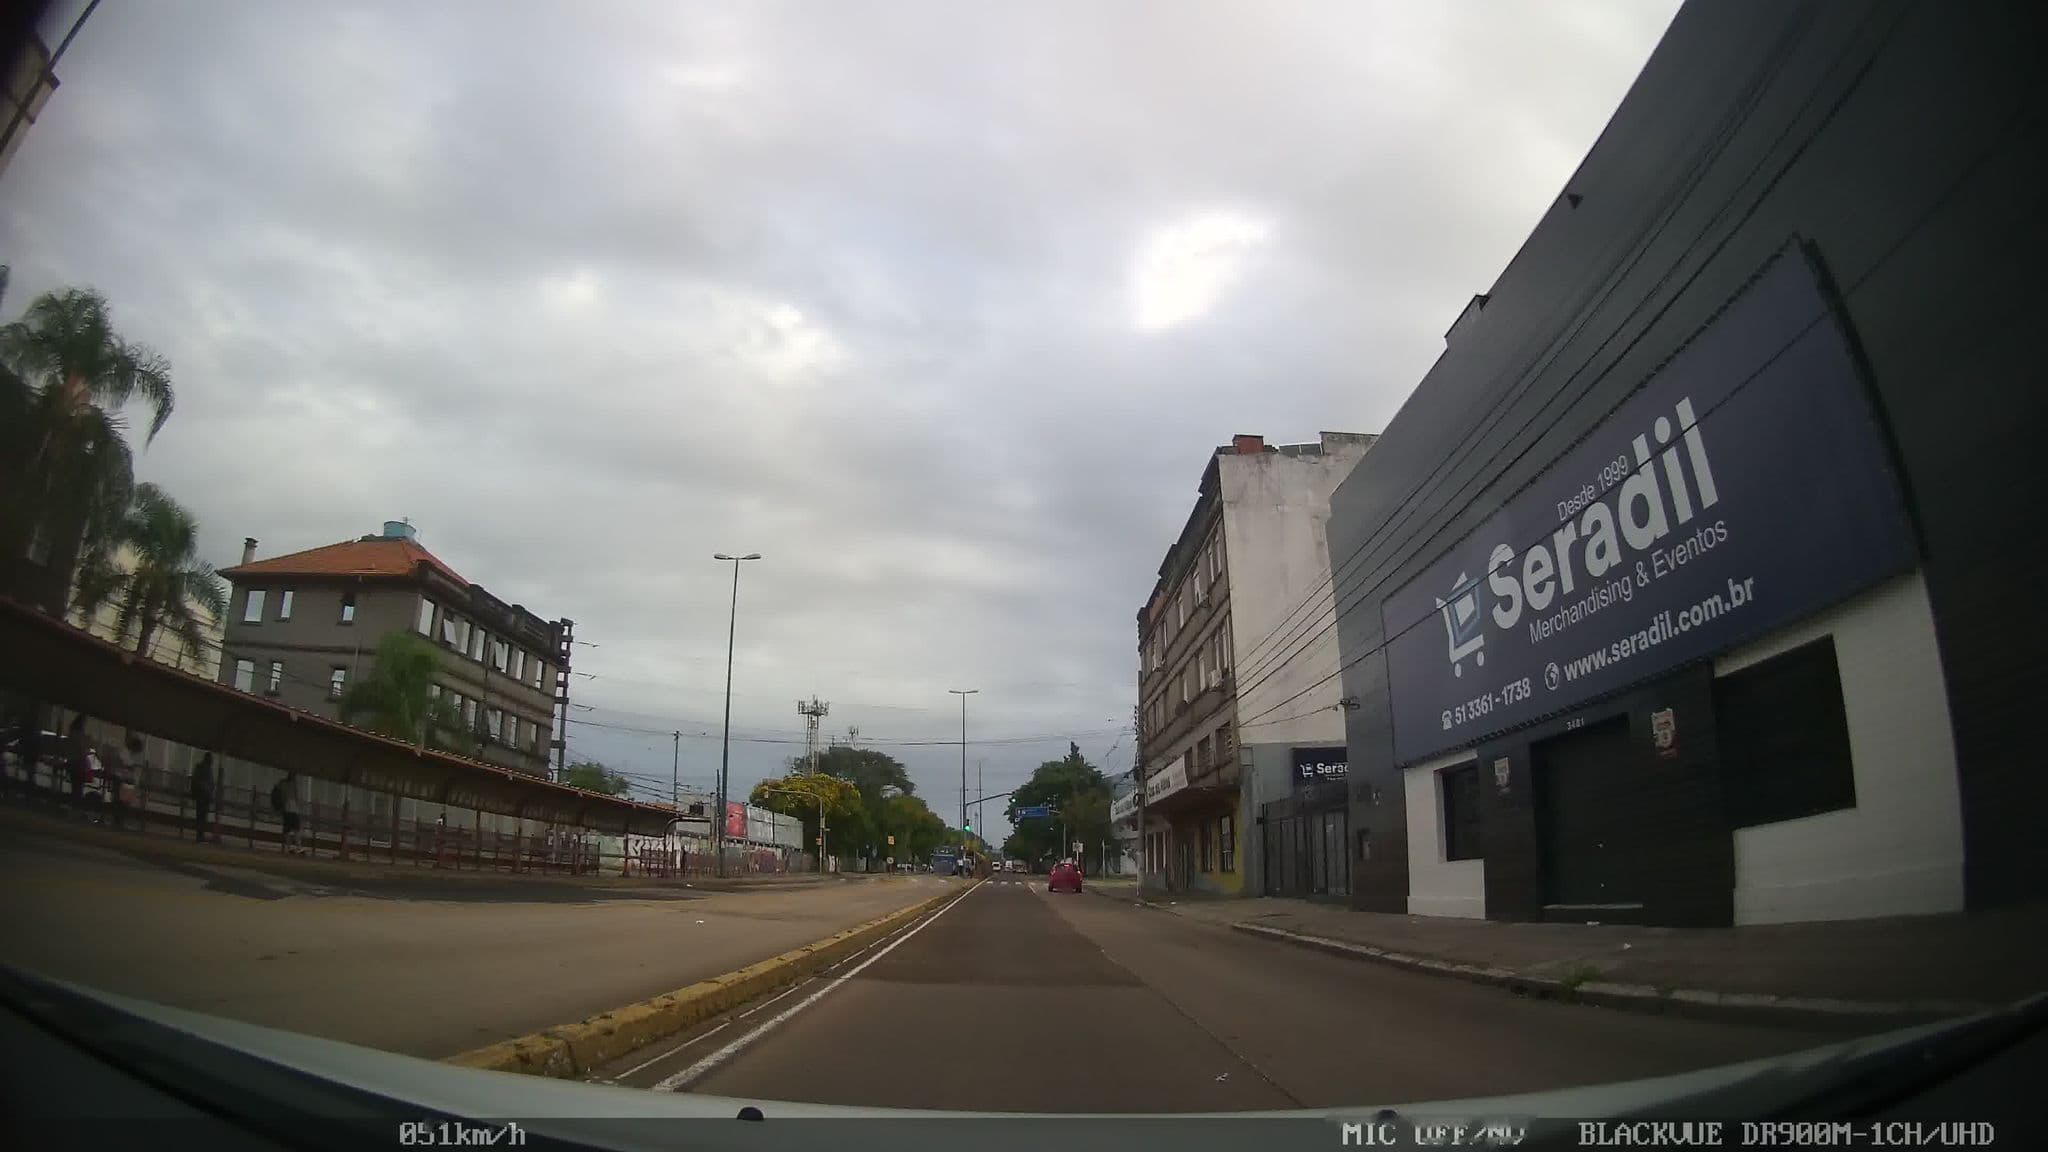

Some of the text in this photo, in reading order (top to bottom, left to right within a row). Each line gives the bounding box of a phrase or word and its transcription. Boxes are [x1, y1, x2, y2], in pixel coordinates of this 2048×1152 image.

[1488, 396, 1719, 630] Seradil
[1557, 455, 1629, 521] Desde 1999
[1529, 520, 1728, 645] Merchandising & Eventos
[1564, 576, 1754, 682] www.seradil.com.br
